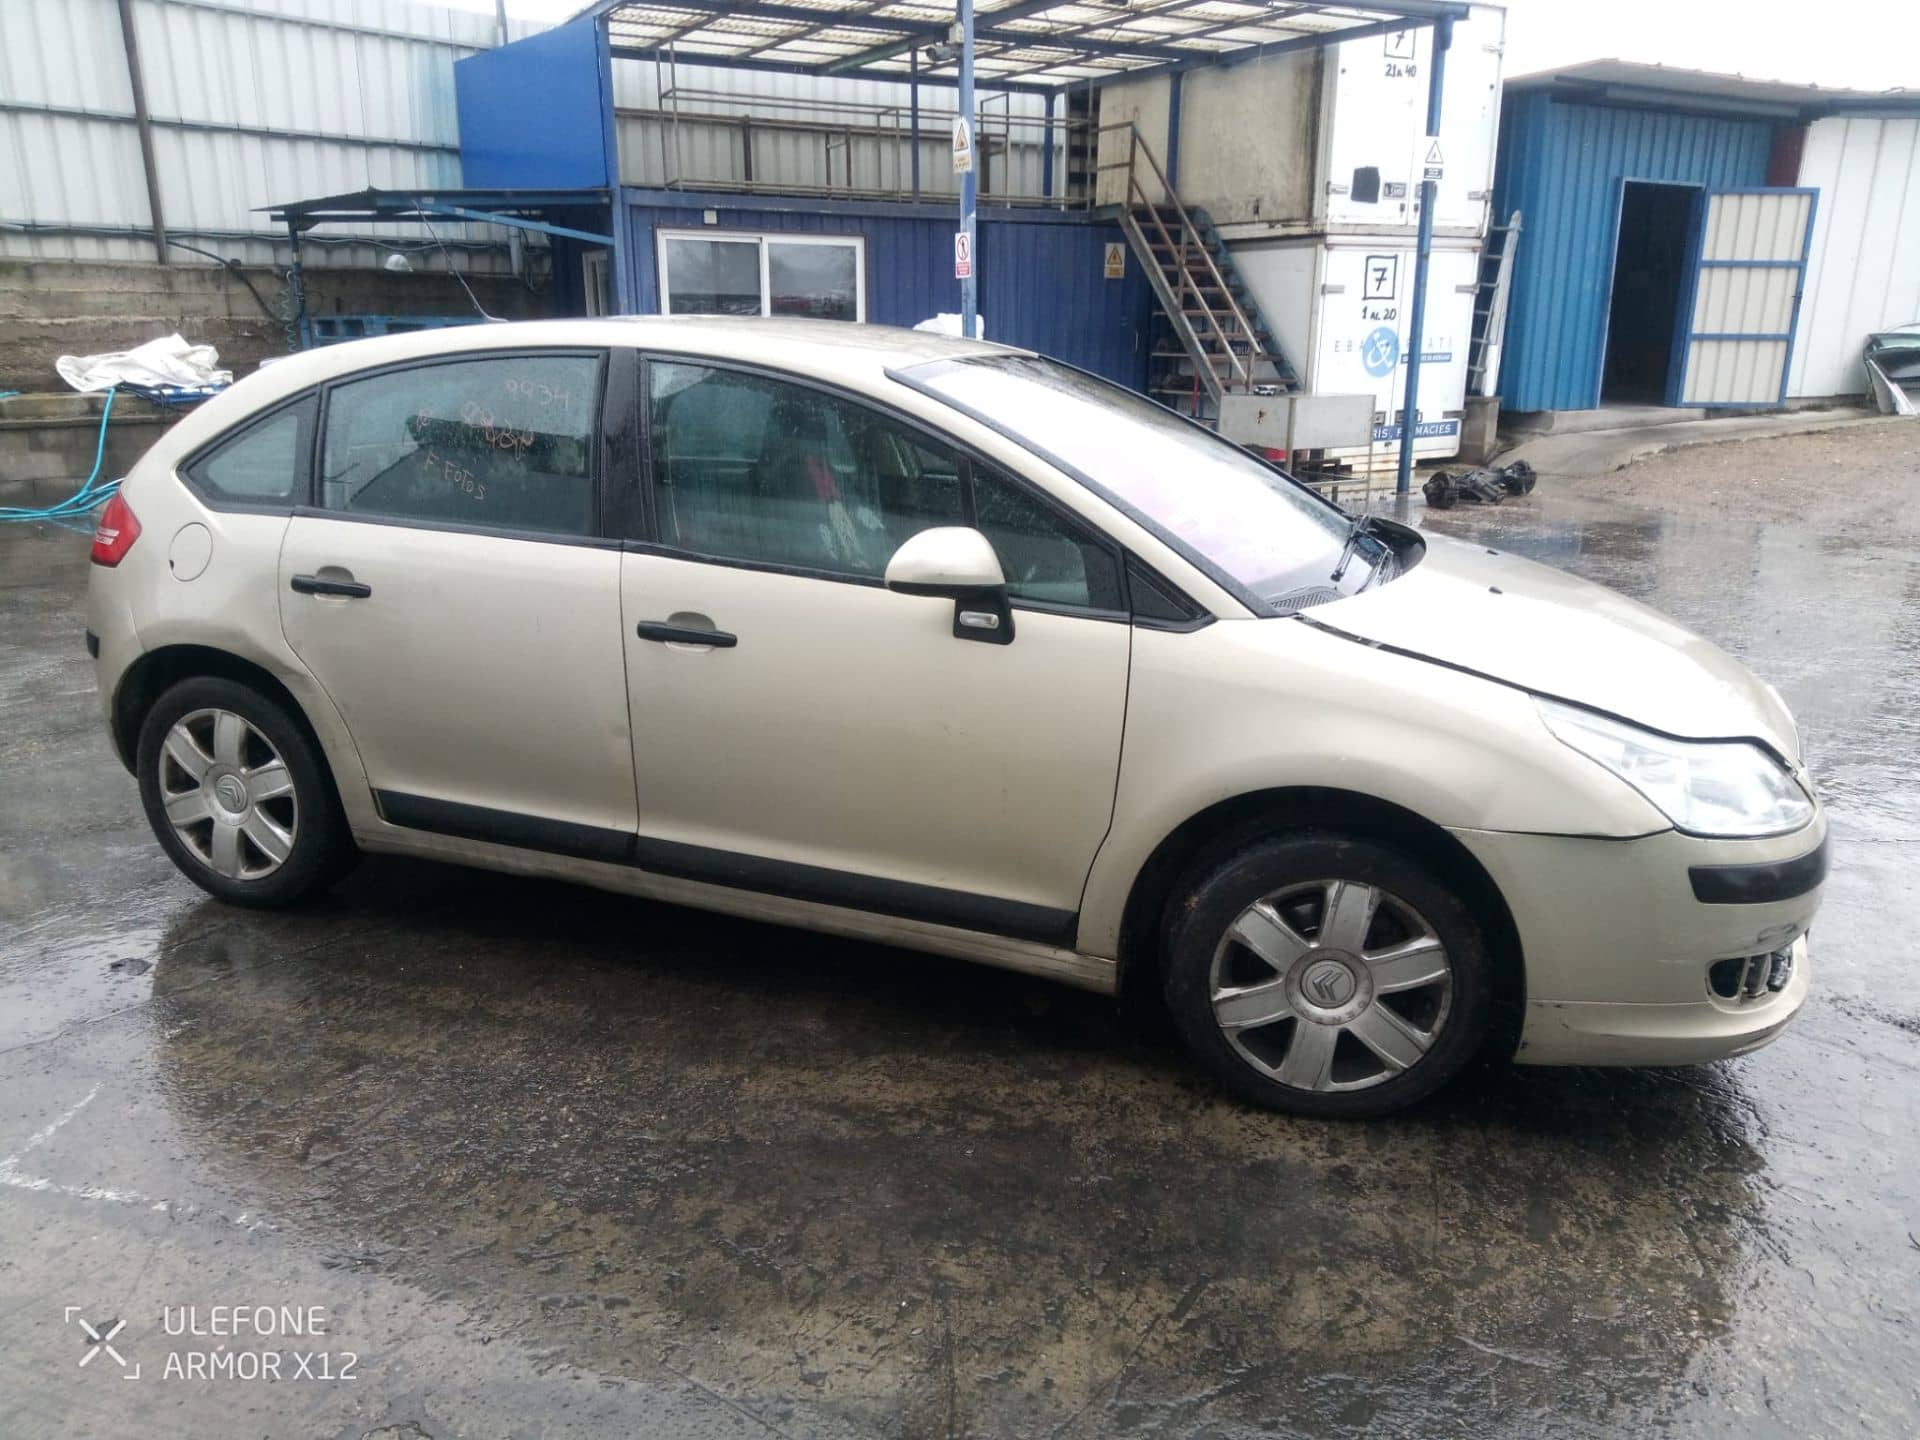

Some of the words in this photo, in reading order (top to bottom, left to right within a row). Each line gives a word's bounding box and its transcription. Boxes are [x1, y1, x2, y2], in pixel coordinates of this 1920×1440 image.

[1405, 64, 1417, 77] 40
[1373, 267, 1387, 291] 7
[1383, 308, 1396, 321] 20
[1396, 424, 1451, 438] FMACIES
